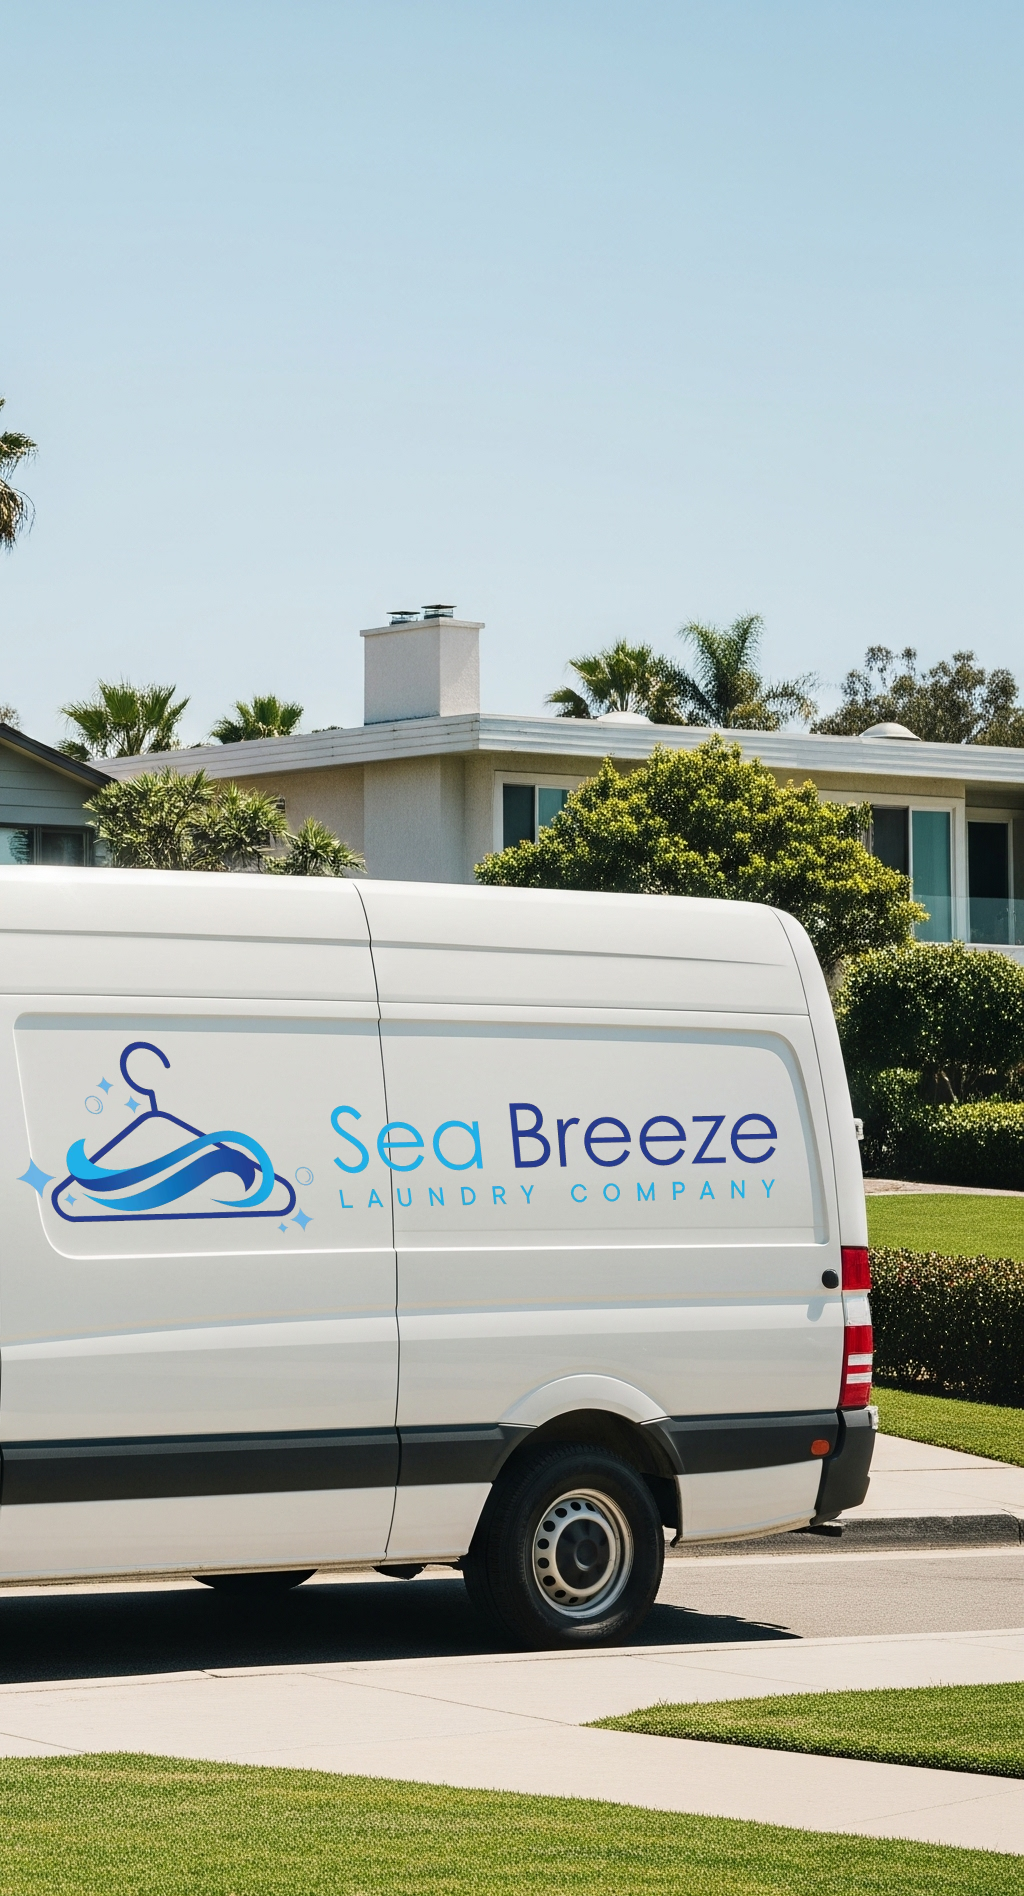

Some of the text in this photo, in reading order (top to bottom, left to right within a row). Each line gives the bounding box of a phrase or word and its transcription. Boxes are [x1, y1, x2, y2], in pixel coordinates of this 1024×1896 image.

[330, 1102, 778, 1174] Sea Breeze
[338, 1178, 777, 1209] LAUNDRY COMPANY
